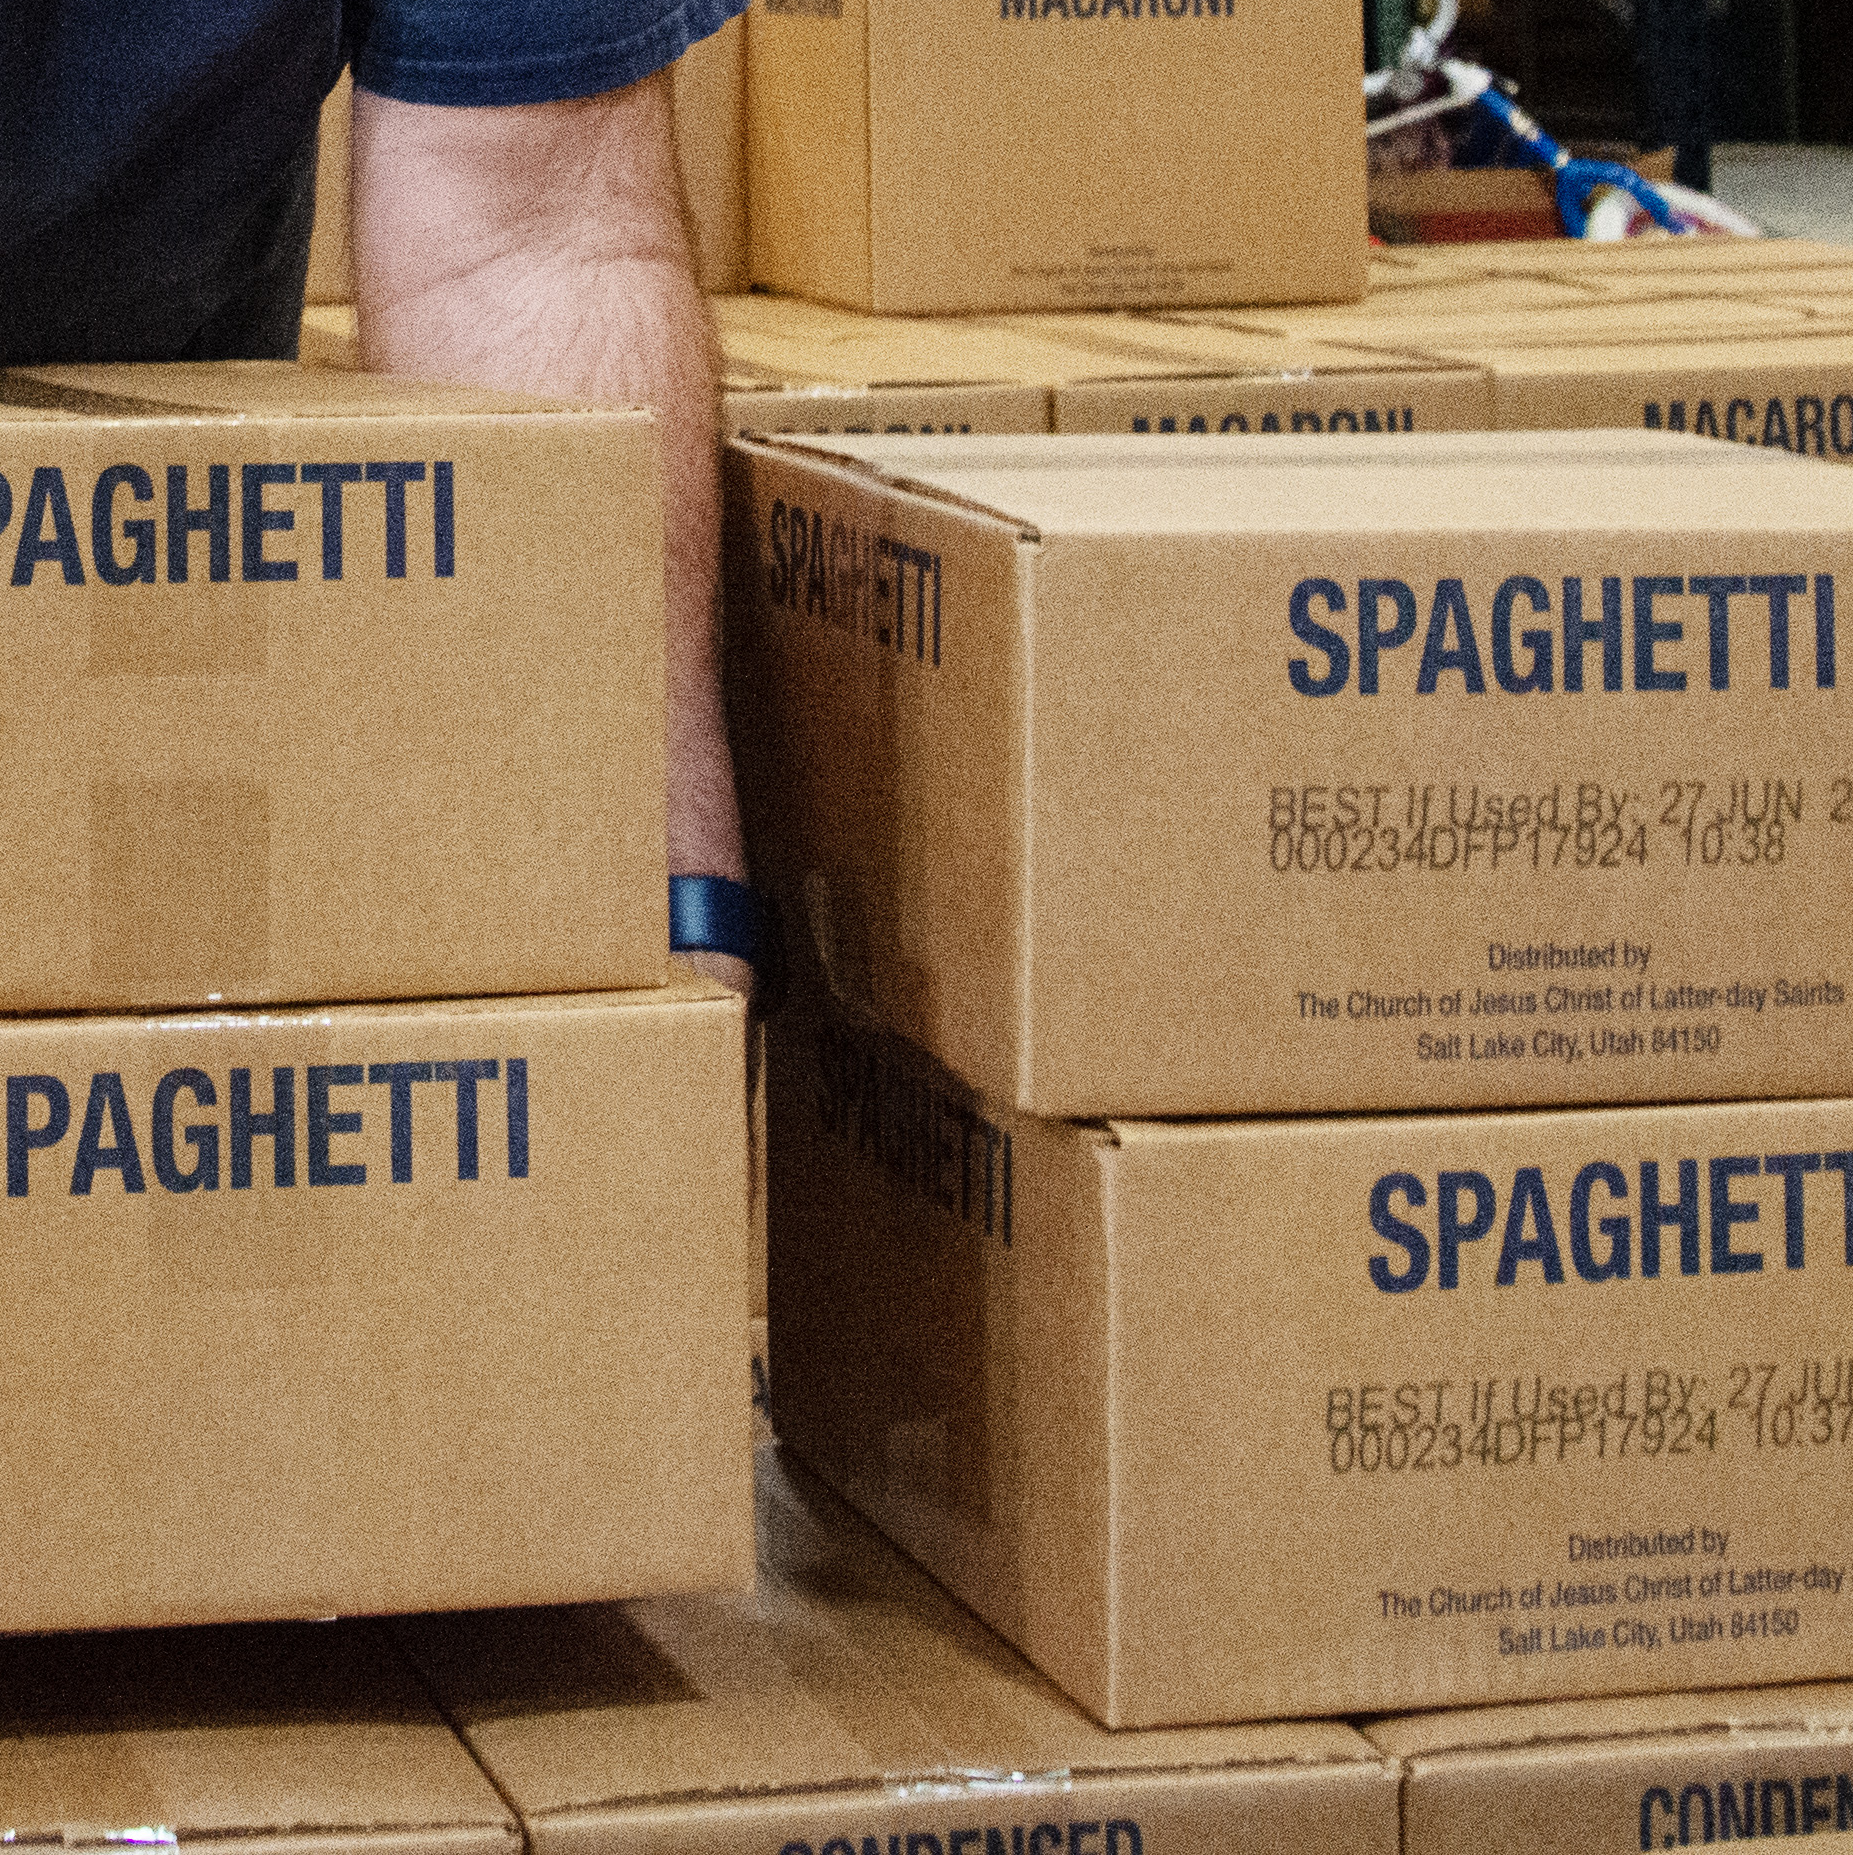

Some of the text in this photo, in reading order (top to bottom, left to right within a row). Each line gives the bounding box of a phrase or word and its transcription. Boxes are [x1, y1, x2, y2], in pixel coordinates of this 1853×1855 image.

[770, 500, 942, 666] SPAGHETTI
[1285, 570, 1839, 699] SPAGHETTI
[1268, 784, 1391, 833] BEST
[1448, 782, 1562, 831] Used
[1658, 779, 1707, 825] 27
[1717, 777, 1803, 824] JUN
[1488, 942, 1653, 973] Distributed by
[1297, 977, 1846, 1018] The Church of Jesus Christ of Latter-day Saints
[1416, 1024, 1722, 1062] Salt Lake City, Utah 84150
[1326, 1378, 1454, 1434] BEST
[1508, 1371, 1629, 1424] Used
[1727, 1361, 1779, 1409] 27
[1788, 1355, 1853, 1406] JU
[1567, 1529, 1730, 1563] Distributed by
[1379, 1564, 1844, 1618] The Church of Jesus Christ of Latter-day
[1499, 1609, 1801, 1655] Salt Lake City, Utah 84150
